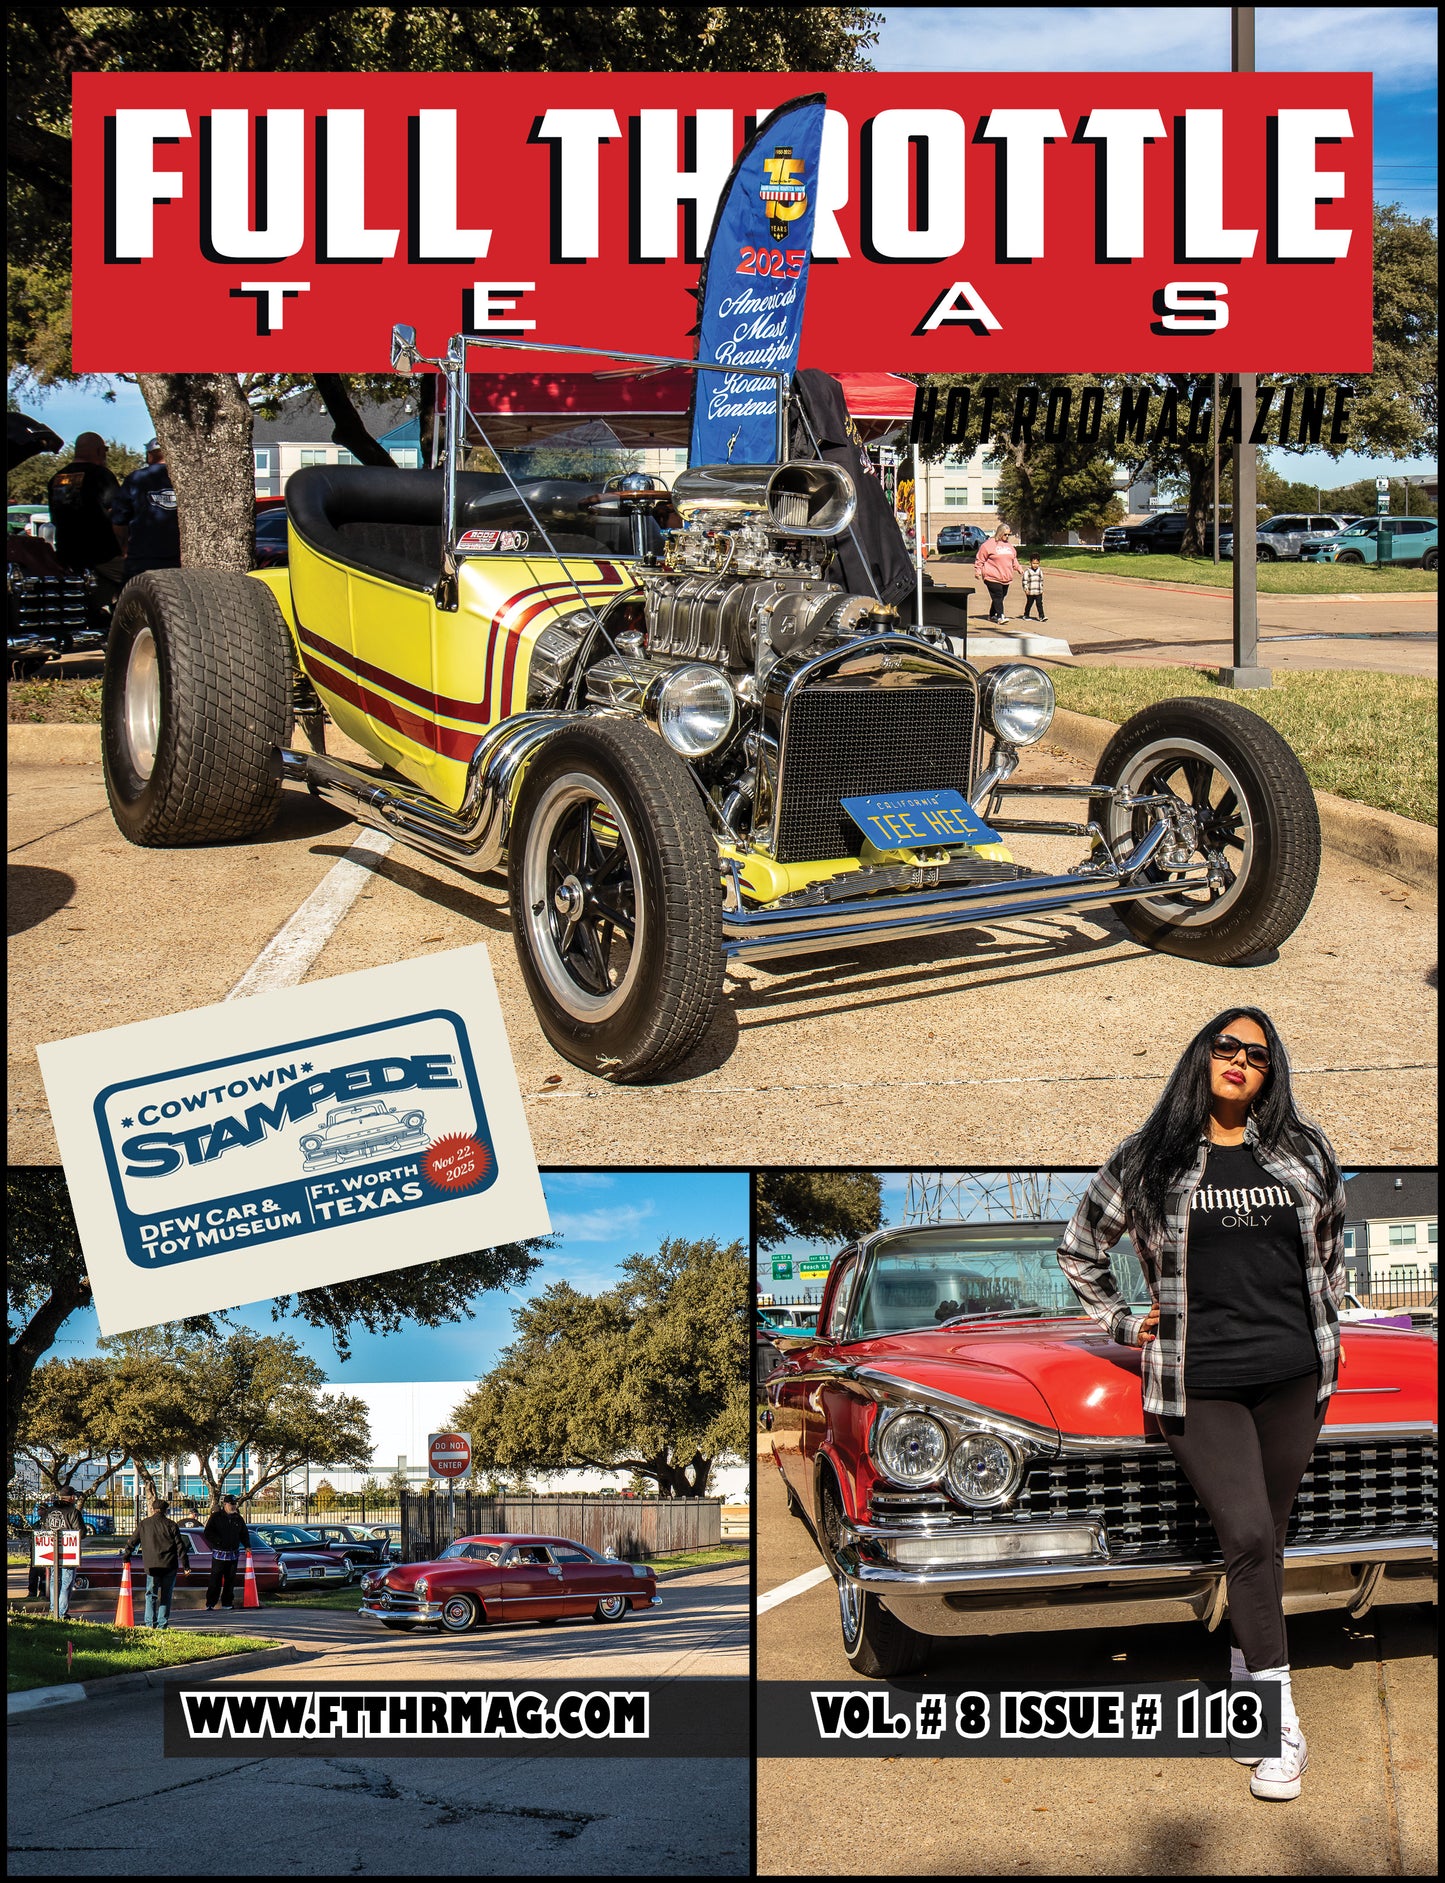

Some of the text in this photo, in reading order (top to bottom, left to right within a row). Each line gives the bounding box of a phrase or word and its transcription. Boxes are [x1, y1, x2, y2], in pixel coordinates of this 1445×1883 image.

[736, 246, 806, 279] 2025
[719, 282, 797, 318] America's
[733, 312, 787, 342] Most
[715, 333, 797, 369] Beautiful
[876, 798, 939, 809] CALIFORNIA
[867, 809, 979, 840] TEE HEE
[1221, 1215, 1272, 1228] ONLY
[438, 1461, 462, 1469] ENTER
[35, 1536, 78, 1547] MUSUM
